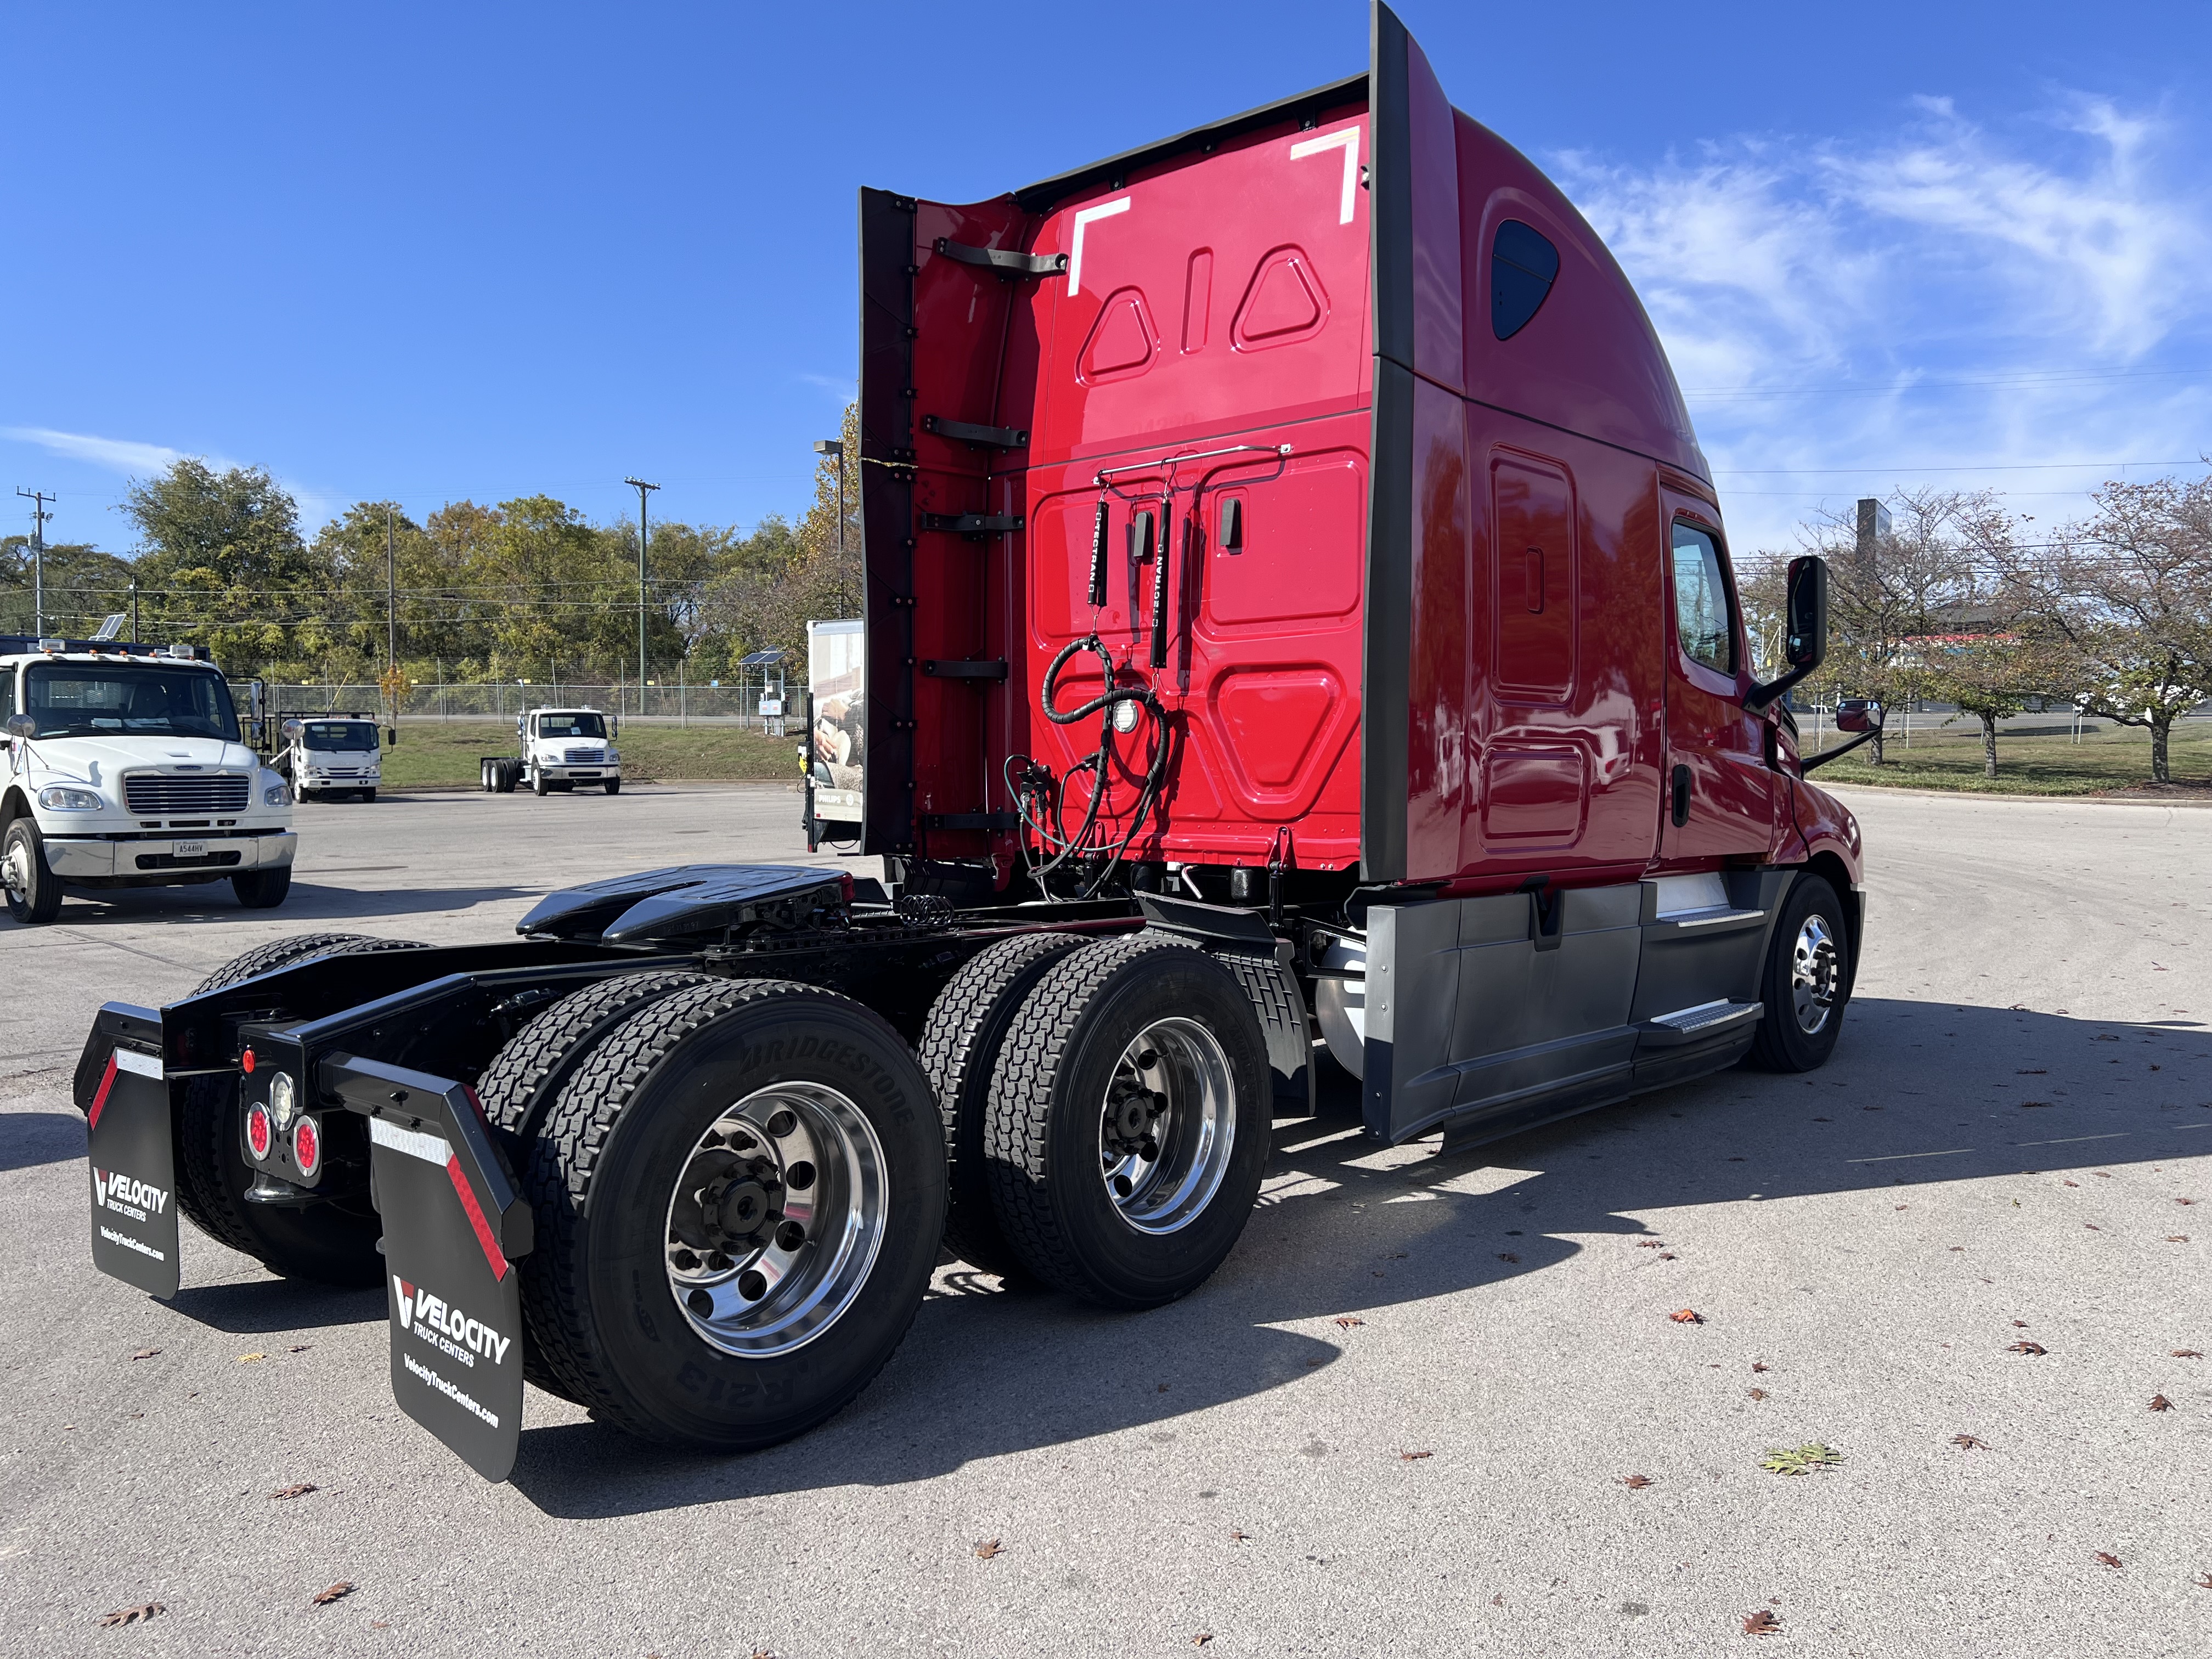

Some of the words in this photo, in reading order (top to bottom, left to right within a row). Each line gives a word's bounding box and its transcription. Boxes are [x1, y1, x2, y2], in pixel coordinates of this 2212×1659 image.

[1090, 523, 1101, 581] TECTRAN
[1153, 556, 1163, 614] TECTRAN
[818, 794, 841, 804] PHILIPS
[179, 844, 203, 853] A544HV
[738, 1035, 915, 1126] BRIDGESTONE
[106, 1198, 123, 1214] TRUCK
[123, 1204, 146, 1222] CENTERS
[108, 1171, 168, 1214] VELOCITY
[100, 1225, 164, 1261] VelocityTruckCenters.com
[414, 1321, 439, 1346] TRUCK
[439, 1336, 475, 1368] CENTERS
[416, 1288, 511, 1365] VELOCITY
[404, 1352, 499, 1429] VelocityTruckCenters.com
[676, 1361, 794, 1408] R213
